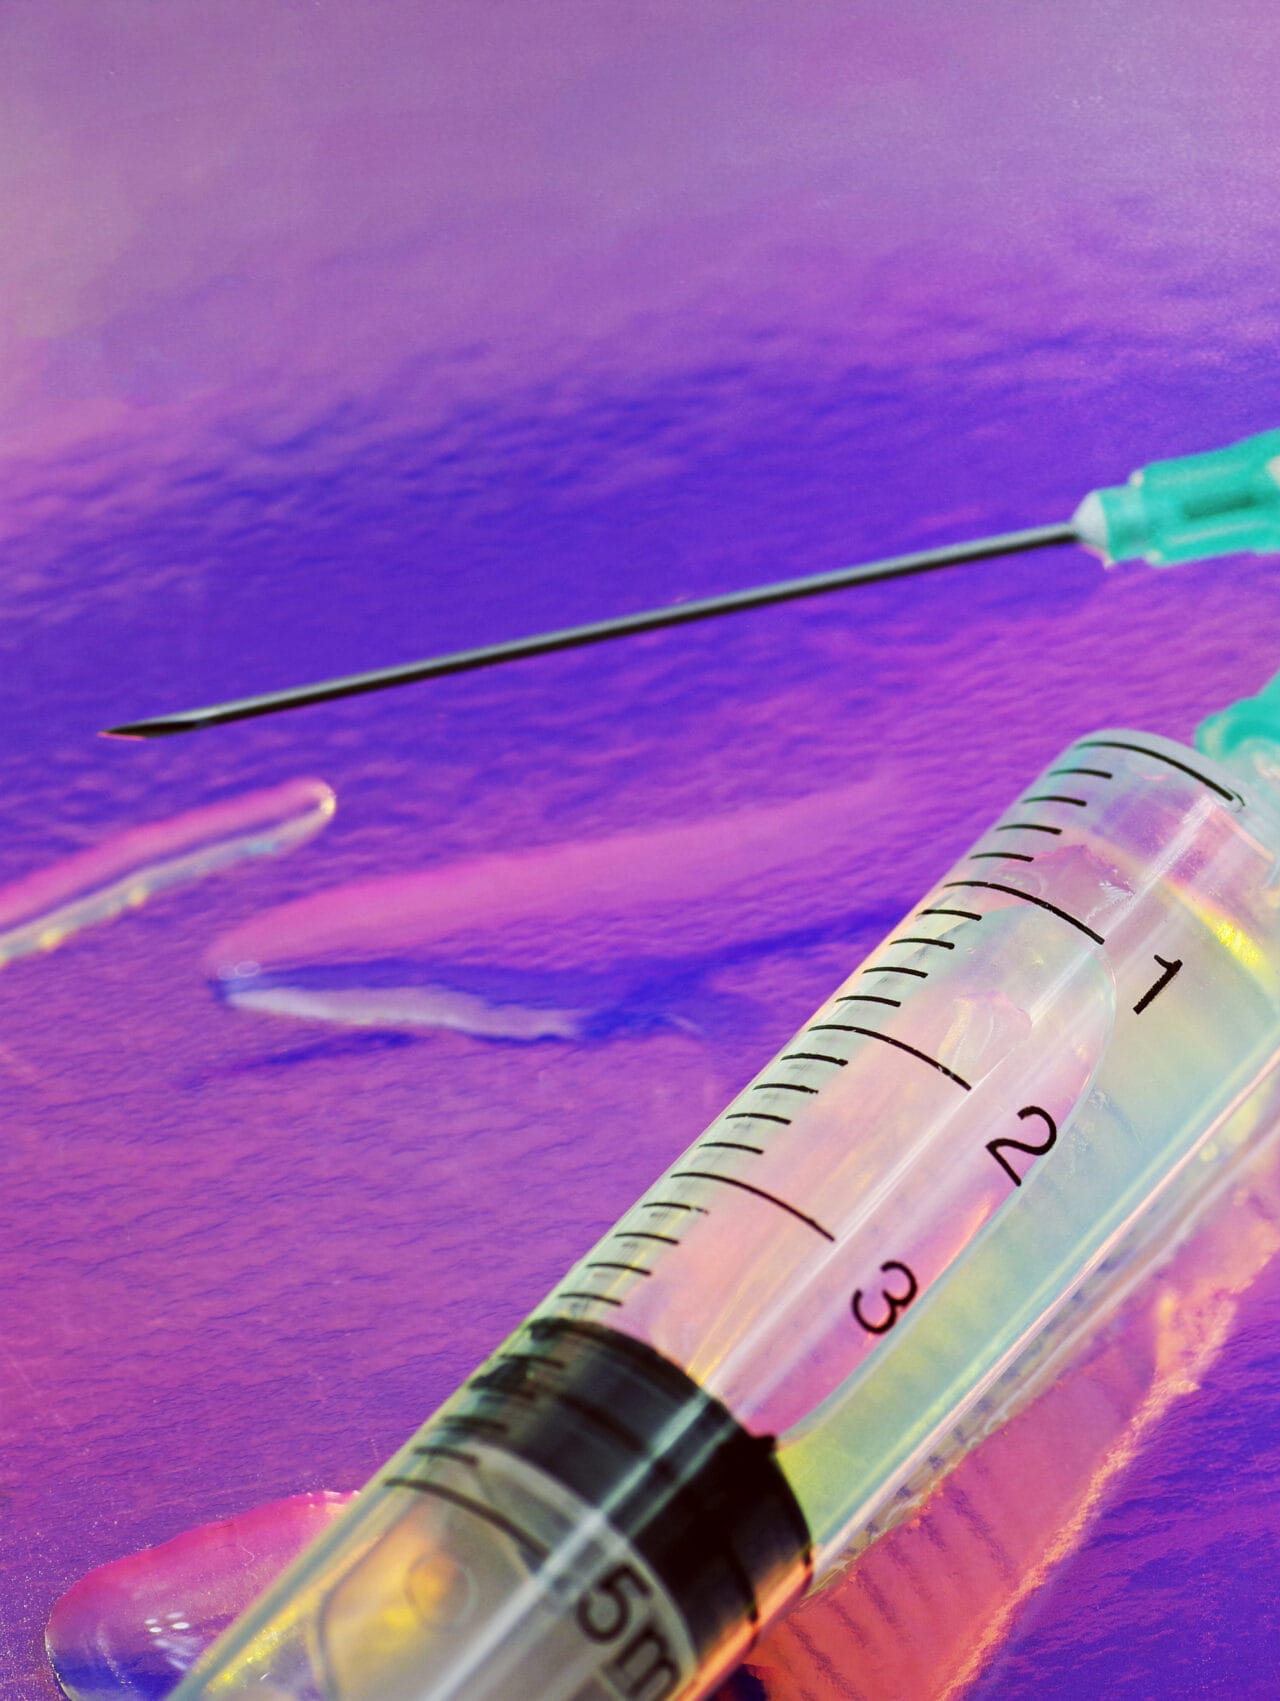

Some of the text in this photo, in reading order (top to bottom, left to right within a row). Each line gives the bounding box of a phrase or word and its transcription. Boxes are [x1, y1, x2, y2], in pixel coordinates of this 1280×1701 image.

[1132, 953, 1184, 1016] 1
[985, 1105, 1058, 1187] 2
[851, 1260, 918, 1335] 3
